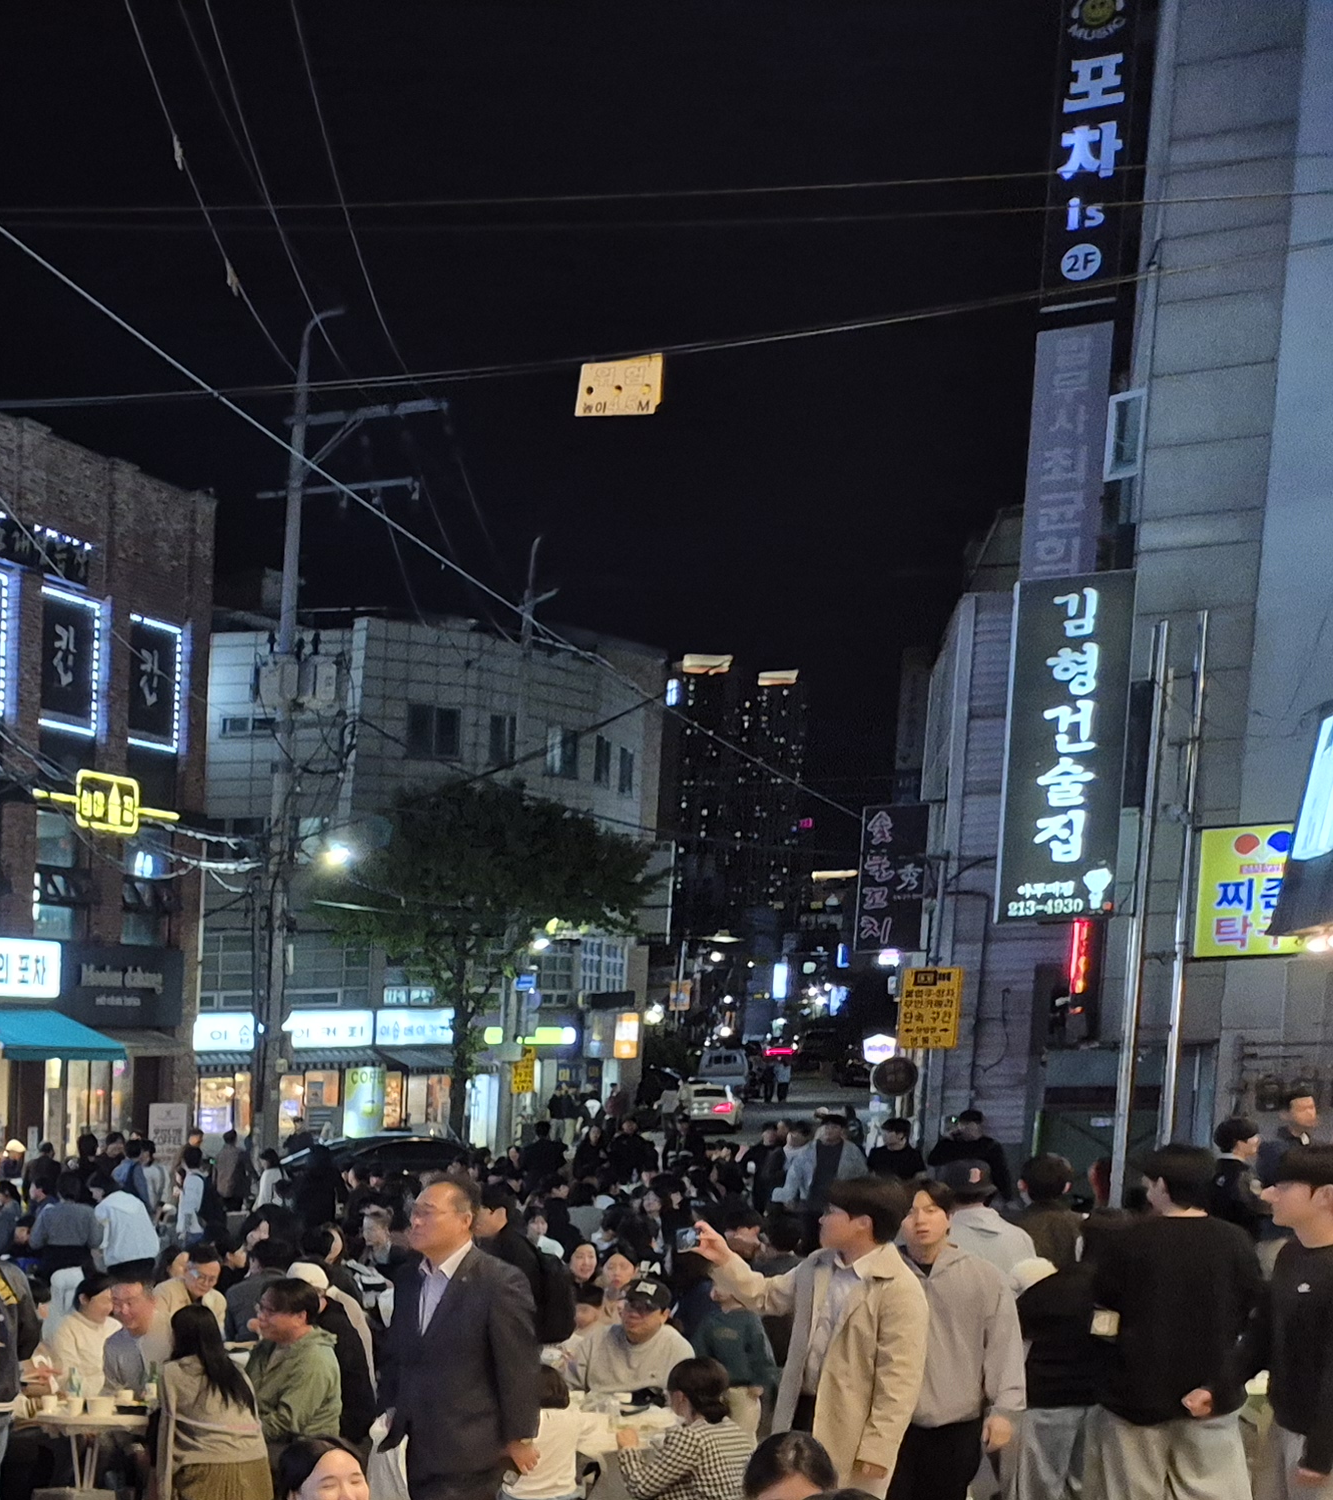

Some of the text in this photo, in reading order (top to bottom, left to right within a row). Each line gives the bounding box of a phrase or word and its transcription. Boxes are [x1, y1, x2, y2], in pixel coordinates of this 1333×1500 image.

[1067, 16, 1126, 41] MUSIC
[1056, 52, 1125, 273] 포차 is 2F
[1033, 586, 1100, 863] 김형건술집
[17, 953, 46, 987] 포차
